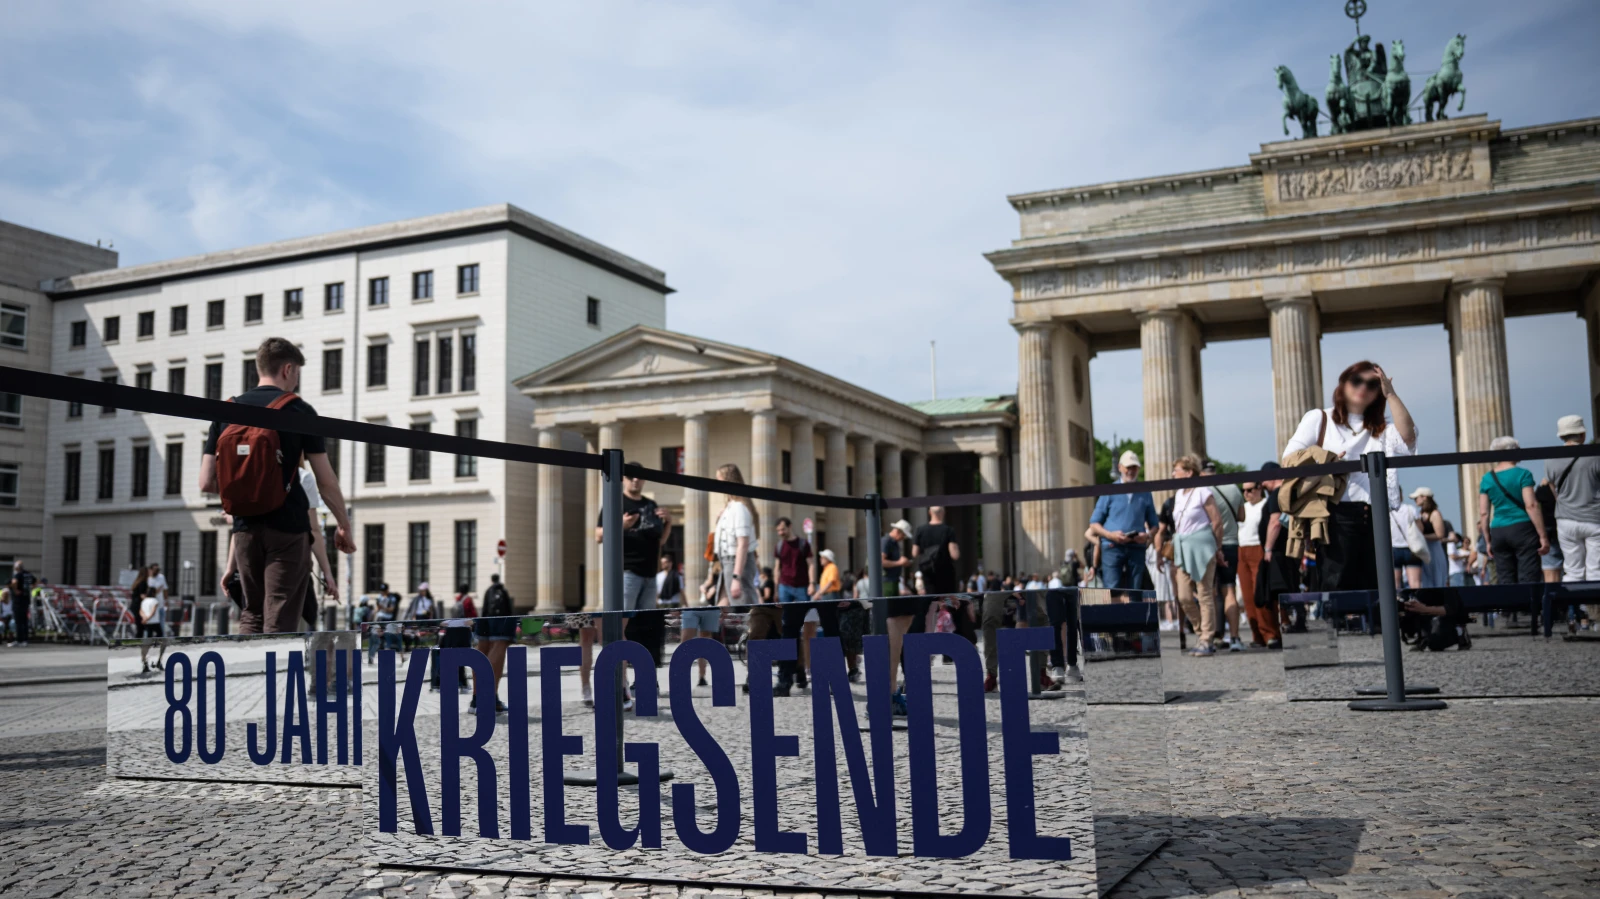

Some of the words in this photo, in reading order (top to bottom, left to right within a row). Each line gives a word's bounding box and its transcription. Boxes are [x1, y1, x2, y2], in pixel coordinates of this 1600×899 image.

[164, 651, 226, 764] 80
[246, 650, 362, 766] JAH
[377, 627, 1072, 860] KRIEGSENDE
